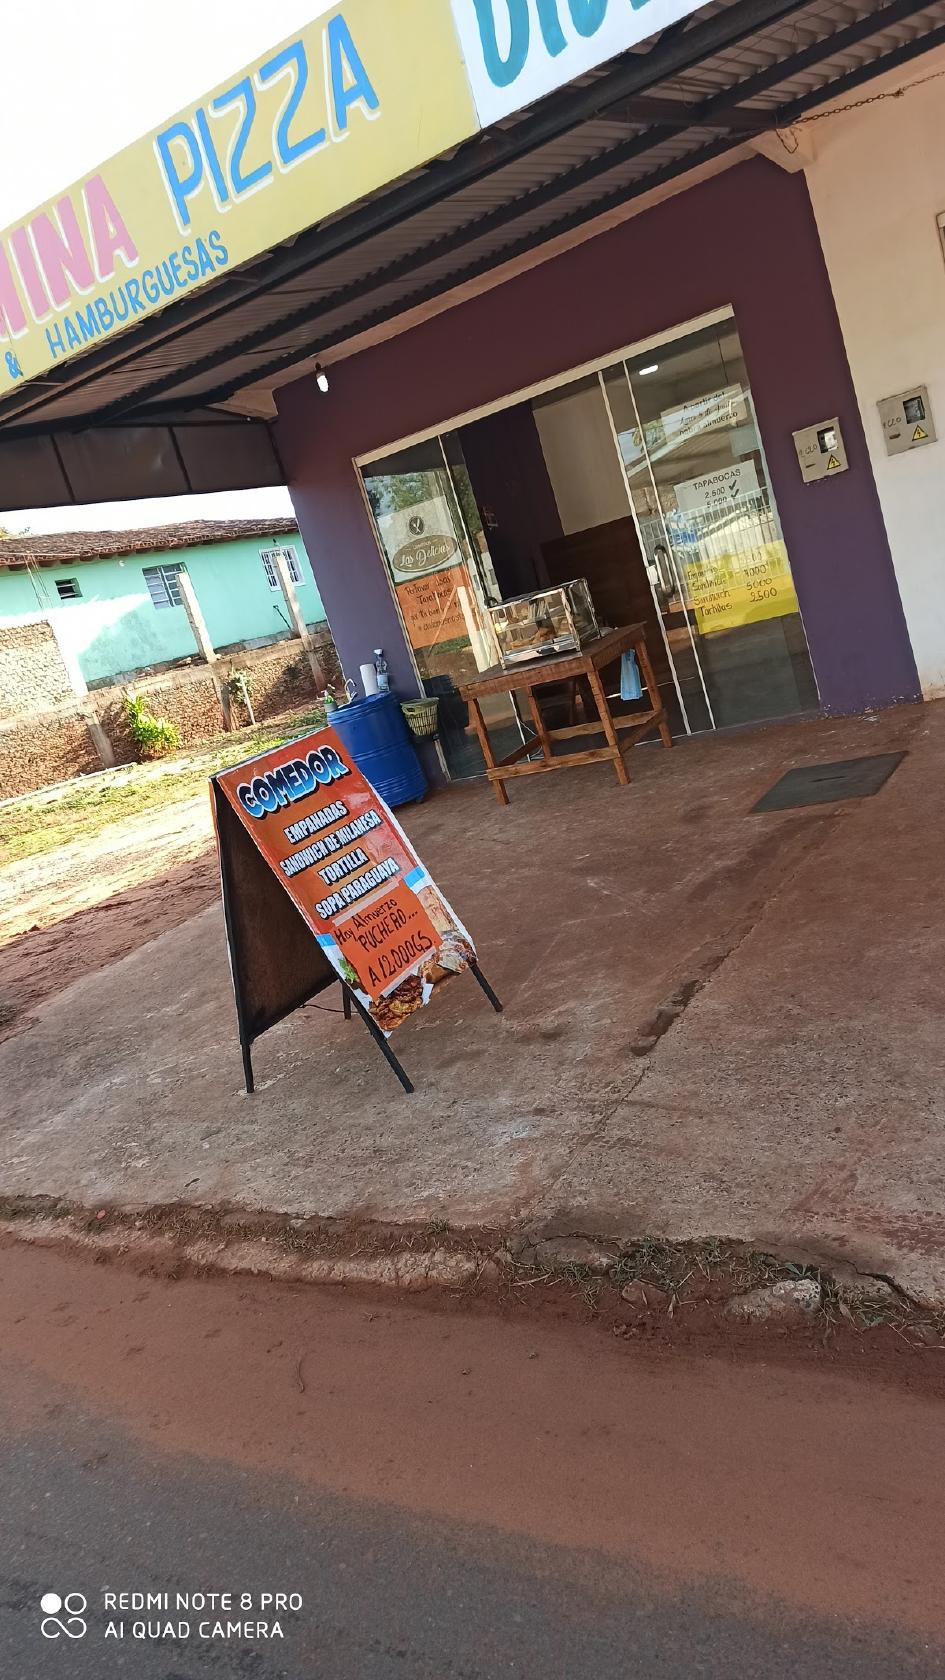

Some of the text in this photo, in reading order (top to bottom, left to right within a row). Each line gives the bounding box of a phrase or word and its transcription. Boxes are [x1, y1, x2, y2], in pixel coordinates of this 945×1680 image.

[153, 14, 380, 236] PIZZA
[5, 230, 228, 379] & HAMBURGUESAS
[693, 469, 741, 490] TAPABOCAS
[750, 587, 777, 602] 2500
[236, 744, 352, 820] COMEDOR
[279, 809, 382, 878] SANDWICH DE MILANESA
[283, 800, 350, 845] EMPANADAS
[315, 857, 401, 920] SOPA PARAGUAYA
[317, 847, 370, 887] TORTILLA
[351, 899, 398, 930] Almuerzo
[368, 965, 382, 987] A
